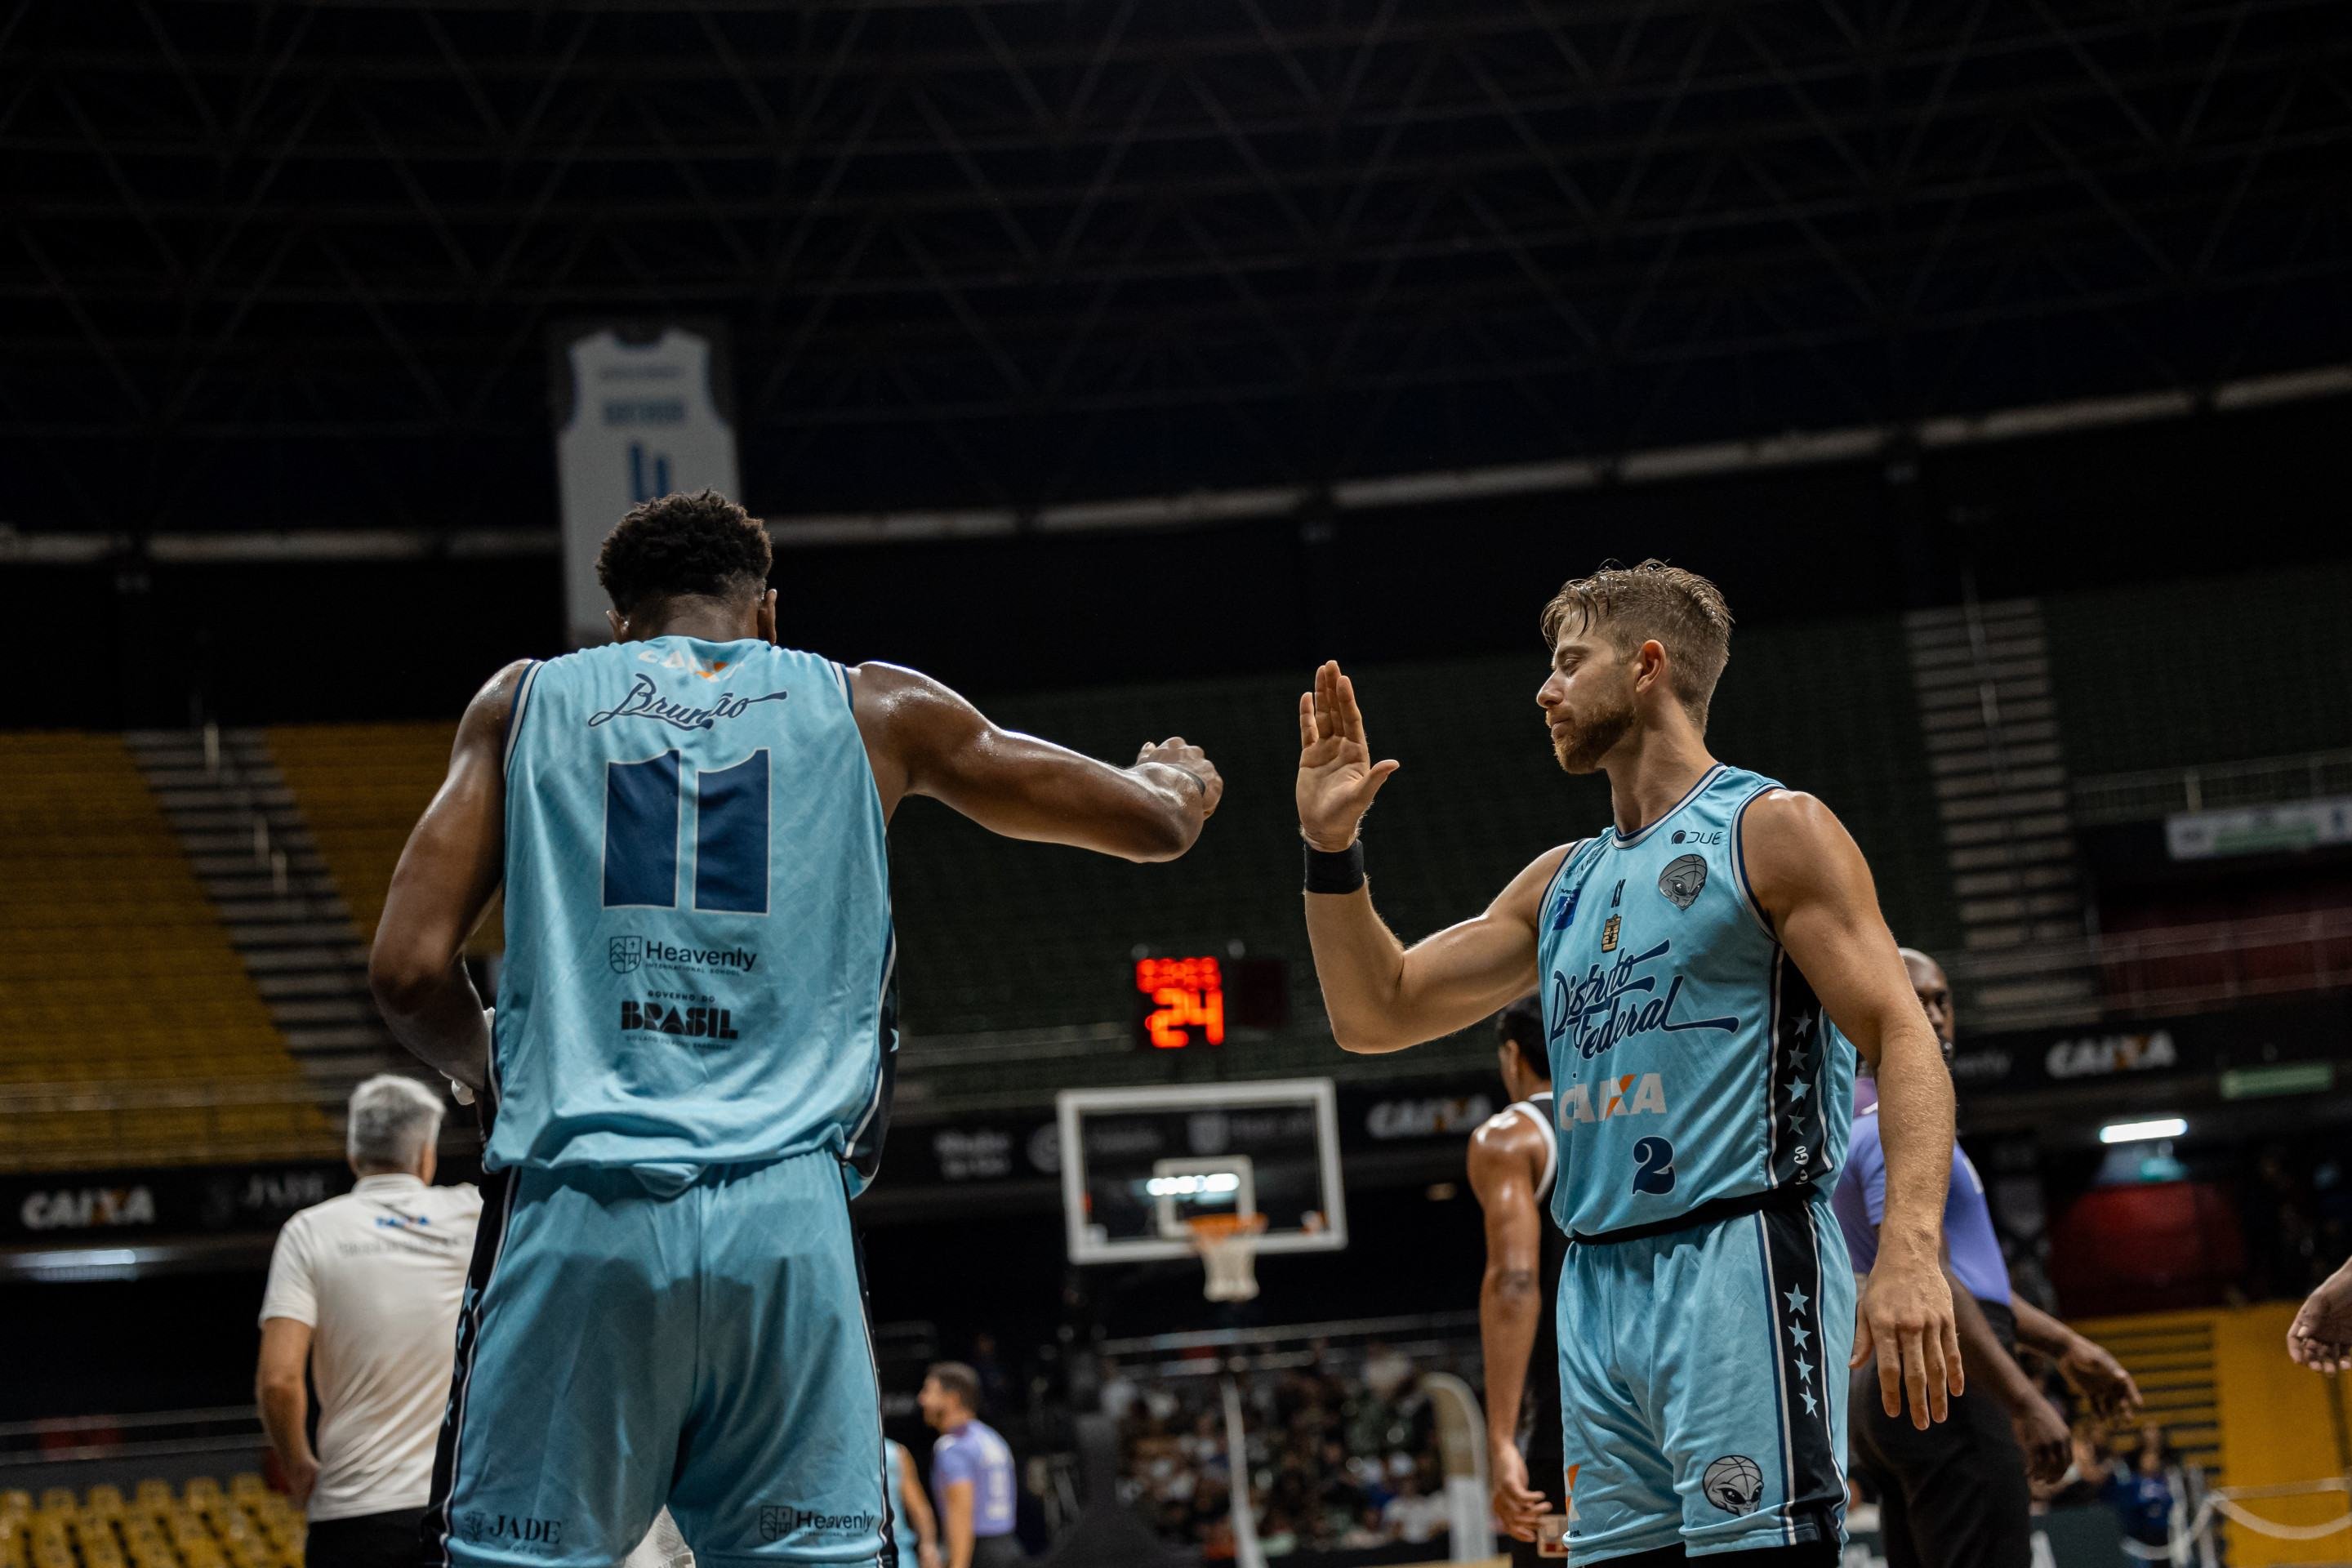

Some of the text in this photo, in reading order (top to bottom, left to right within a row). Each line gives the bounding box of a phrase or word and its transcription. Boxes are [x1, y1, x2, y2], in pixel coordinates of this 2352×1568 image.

[587, 672, 788, 731] Brunão
[602, 747, 771, 914] 11
[646, 940, 758, 972] Heavenly
[648, 989, 697, 1002] GOVERNO
[1145, 987, 1224, 1049] 24
[1551, 938, 1671, 1042] Distrito
[1573, 974, 1740, 1061] Federal
[621, 1000, 739, 1040] BRASIL
[1559, 1071, 1668, 1132] CAIXA
[1632, 1135, 1676, 1196] 2
[20, 1185, 155, 1232] CAIXA
[488, 1515, 562, 1544] JADE
[796, 1509, 875, 1534] Heavenly
